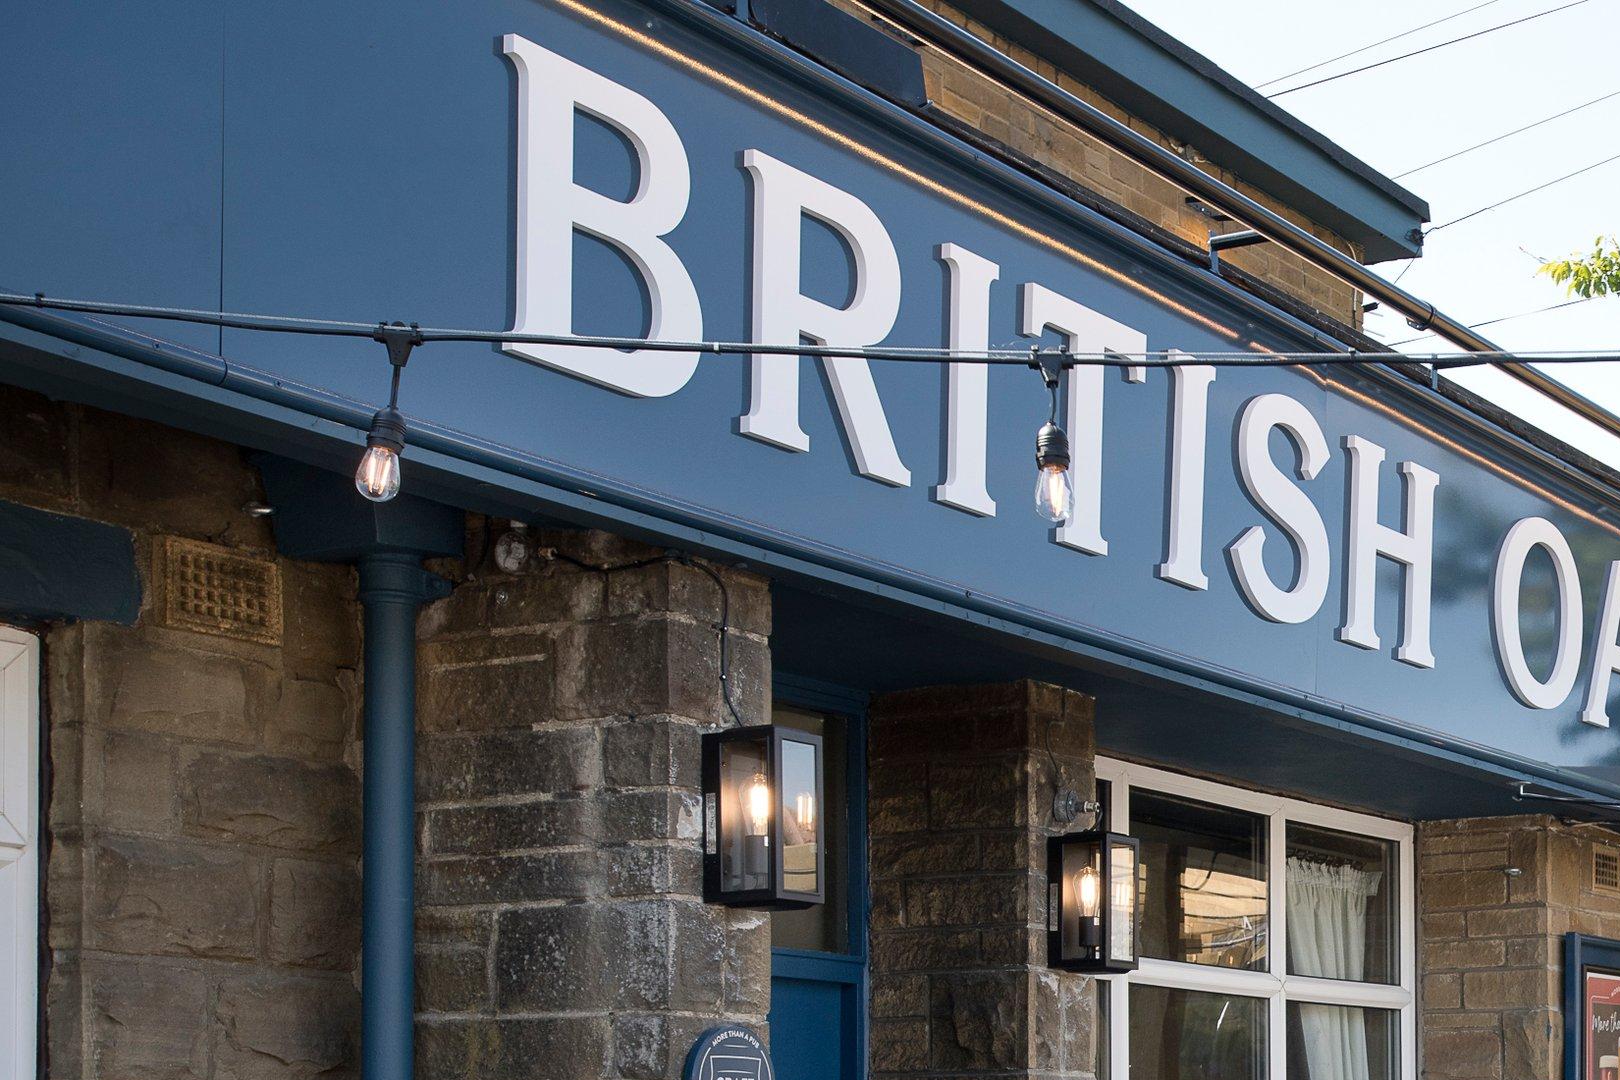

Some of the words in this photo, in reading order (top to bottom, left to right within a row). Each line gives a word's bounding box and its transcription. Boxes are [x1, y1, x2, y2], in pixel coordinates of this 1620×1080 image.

[502, 33, 1440, 669] BRITISH
[1591, 1014, 1610, 1033] More
[712, 1033, 728, 1047] MORE
[728, 1030, 744, 1039] THAN
[749, 1036, 760, 1049] PUB
